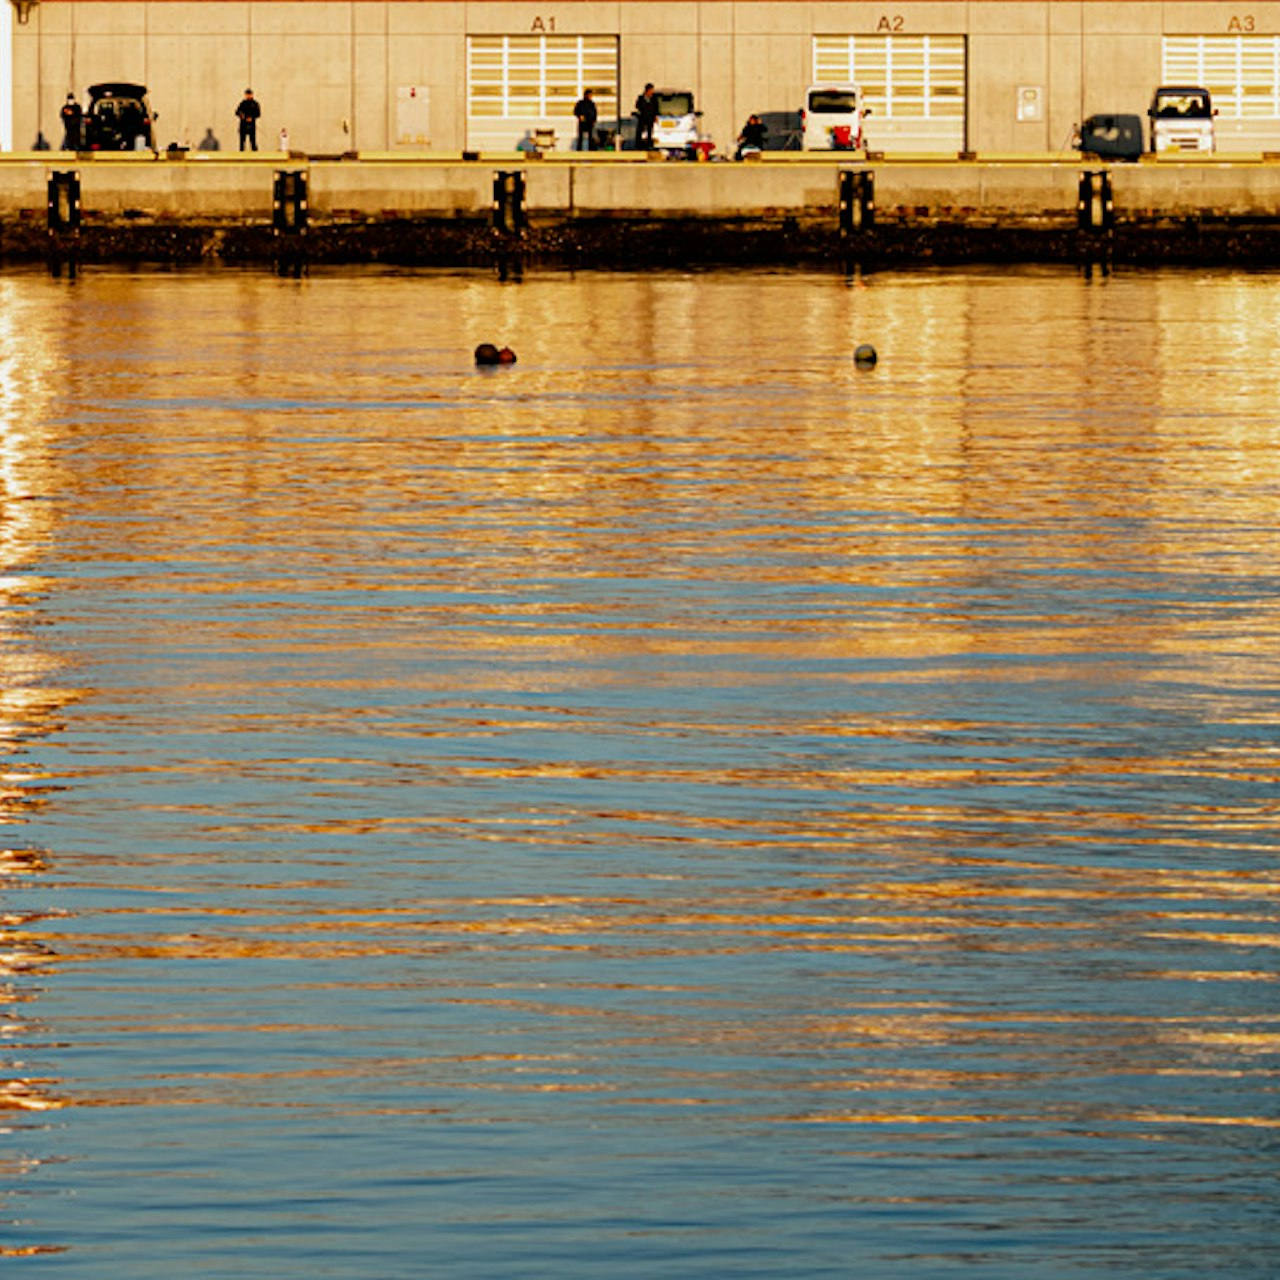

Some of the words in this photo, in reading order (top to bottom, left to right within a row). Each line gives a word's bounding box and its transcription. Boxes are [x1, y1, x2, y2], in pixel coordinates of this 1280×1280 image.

[531, 16, 555, 31] A1
[877, 15, 904, 31] A2
[1228, 15, 1255, 31] A3
